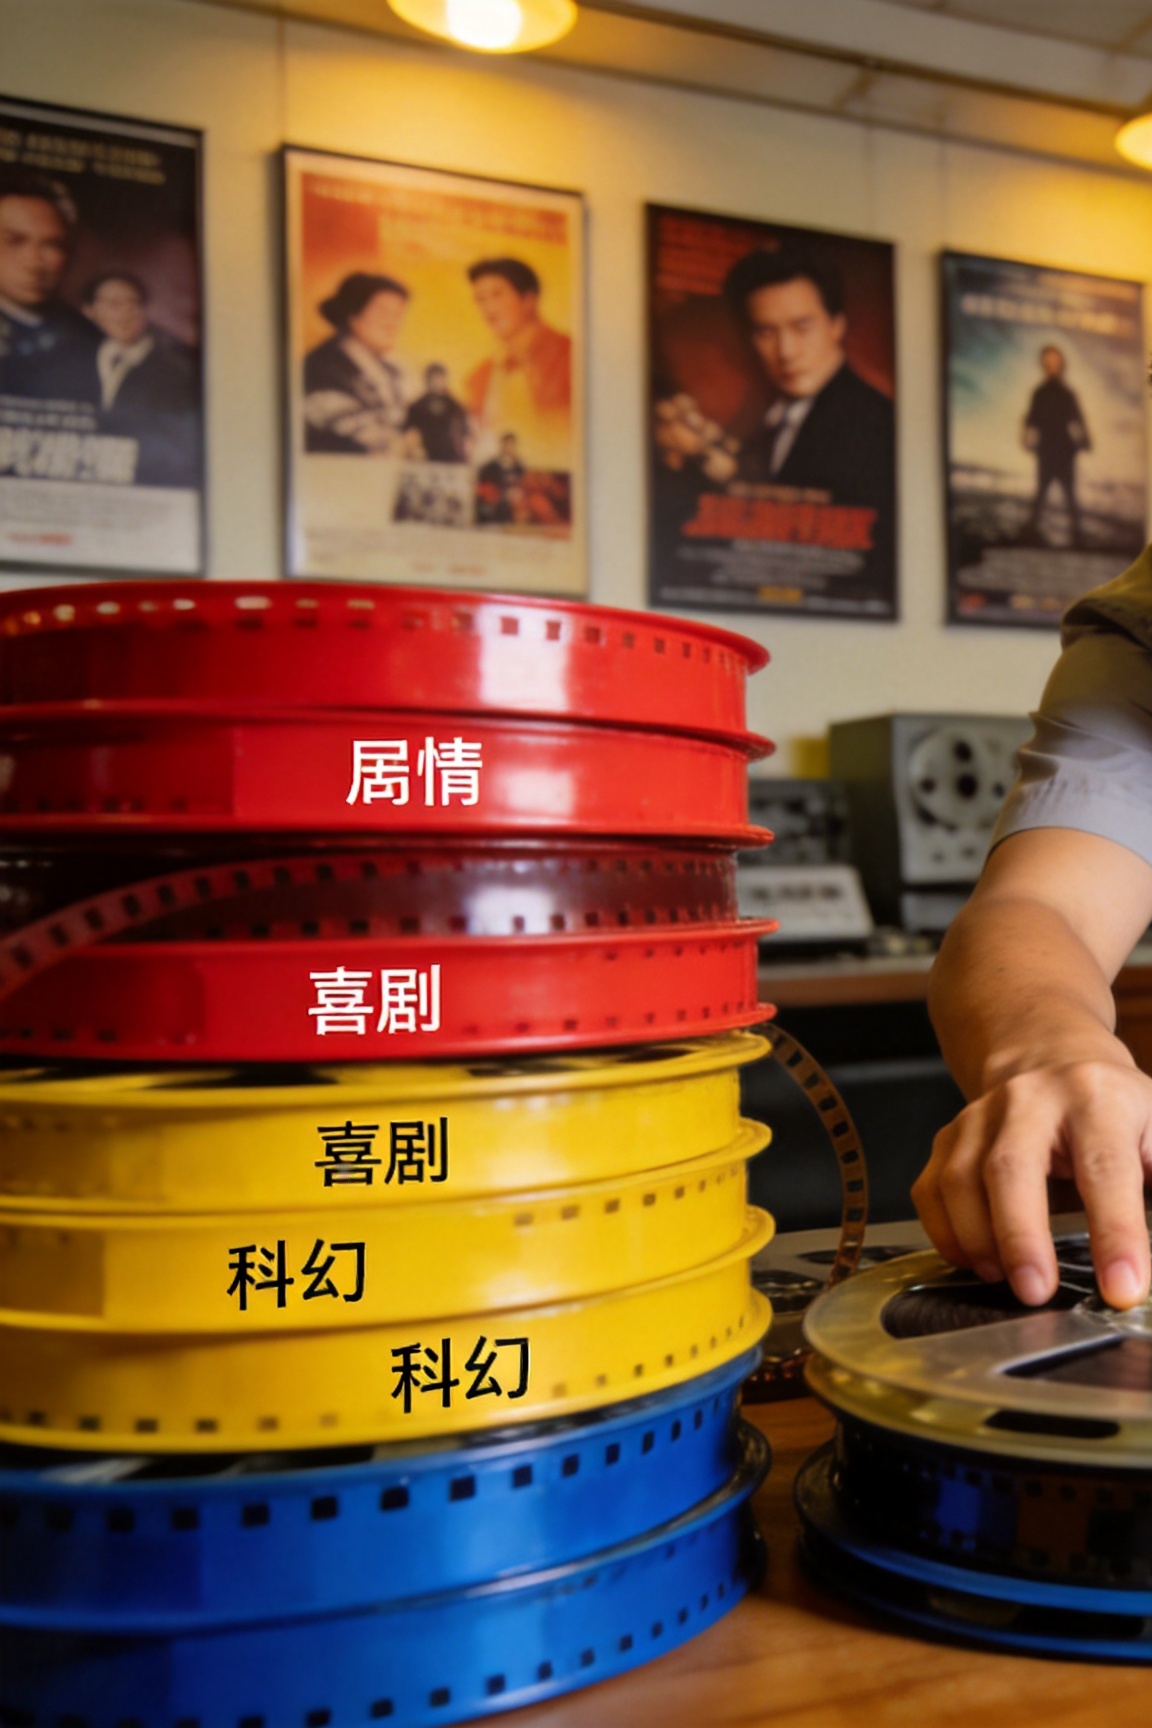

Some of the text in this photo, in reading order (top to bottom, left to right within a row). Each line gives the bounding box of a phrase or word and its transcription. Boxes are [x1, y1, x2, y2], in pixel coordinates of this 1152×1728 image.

[308, 964, 440, 1035] 喜剧
[315, 1117, 448, 1187] 喜剧
[226, 1239, 366, 1311] 科幻
[391, 1336, 529, 1414] 科幻
